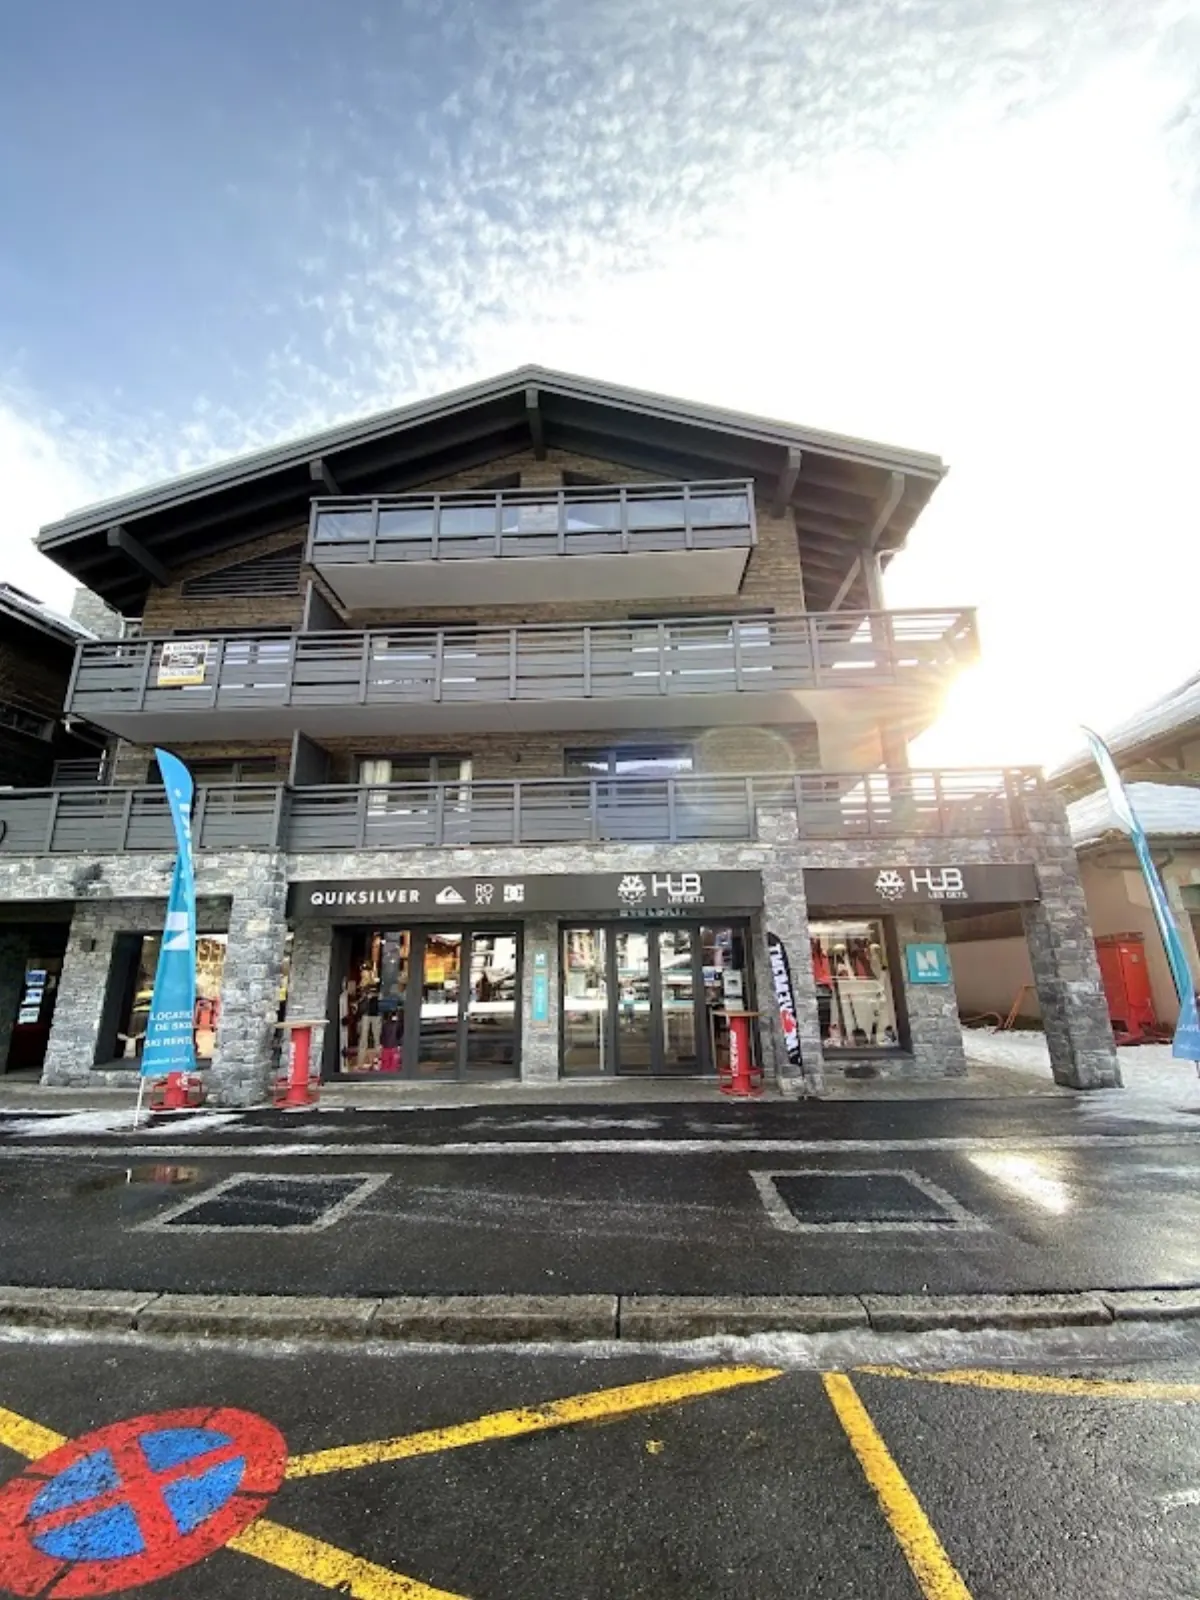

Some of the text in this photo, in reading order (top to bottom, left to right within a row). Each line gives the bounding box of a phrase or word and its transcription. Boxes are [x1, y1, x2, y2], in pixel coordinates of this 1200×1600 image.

[652, 873, 702, 897] HUB
[909, 868, 964, 892] HUB
[310, 889, 420, 905] QUIKSILVER
